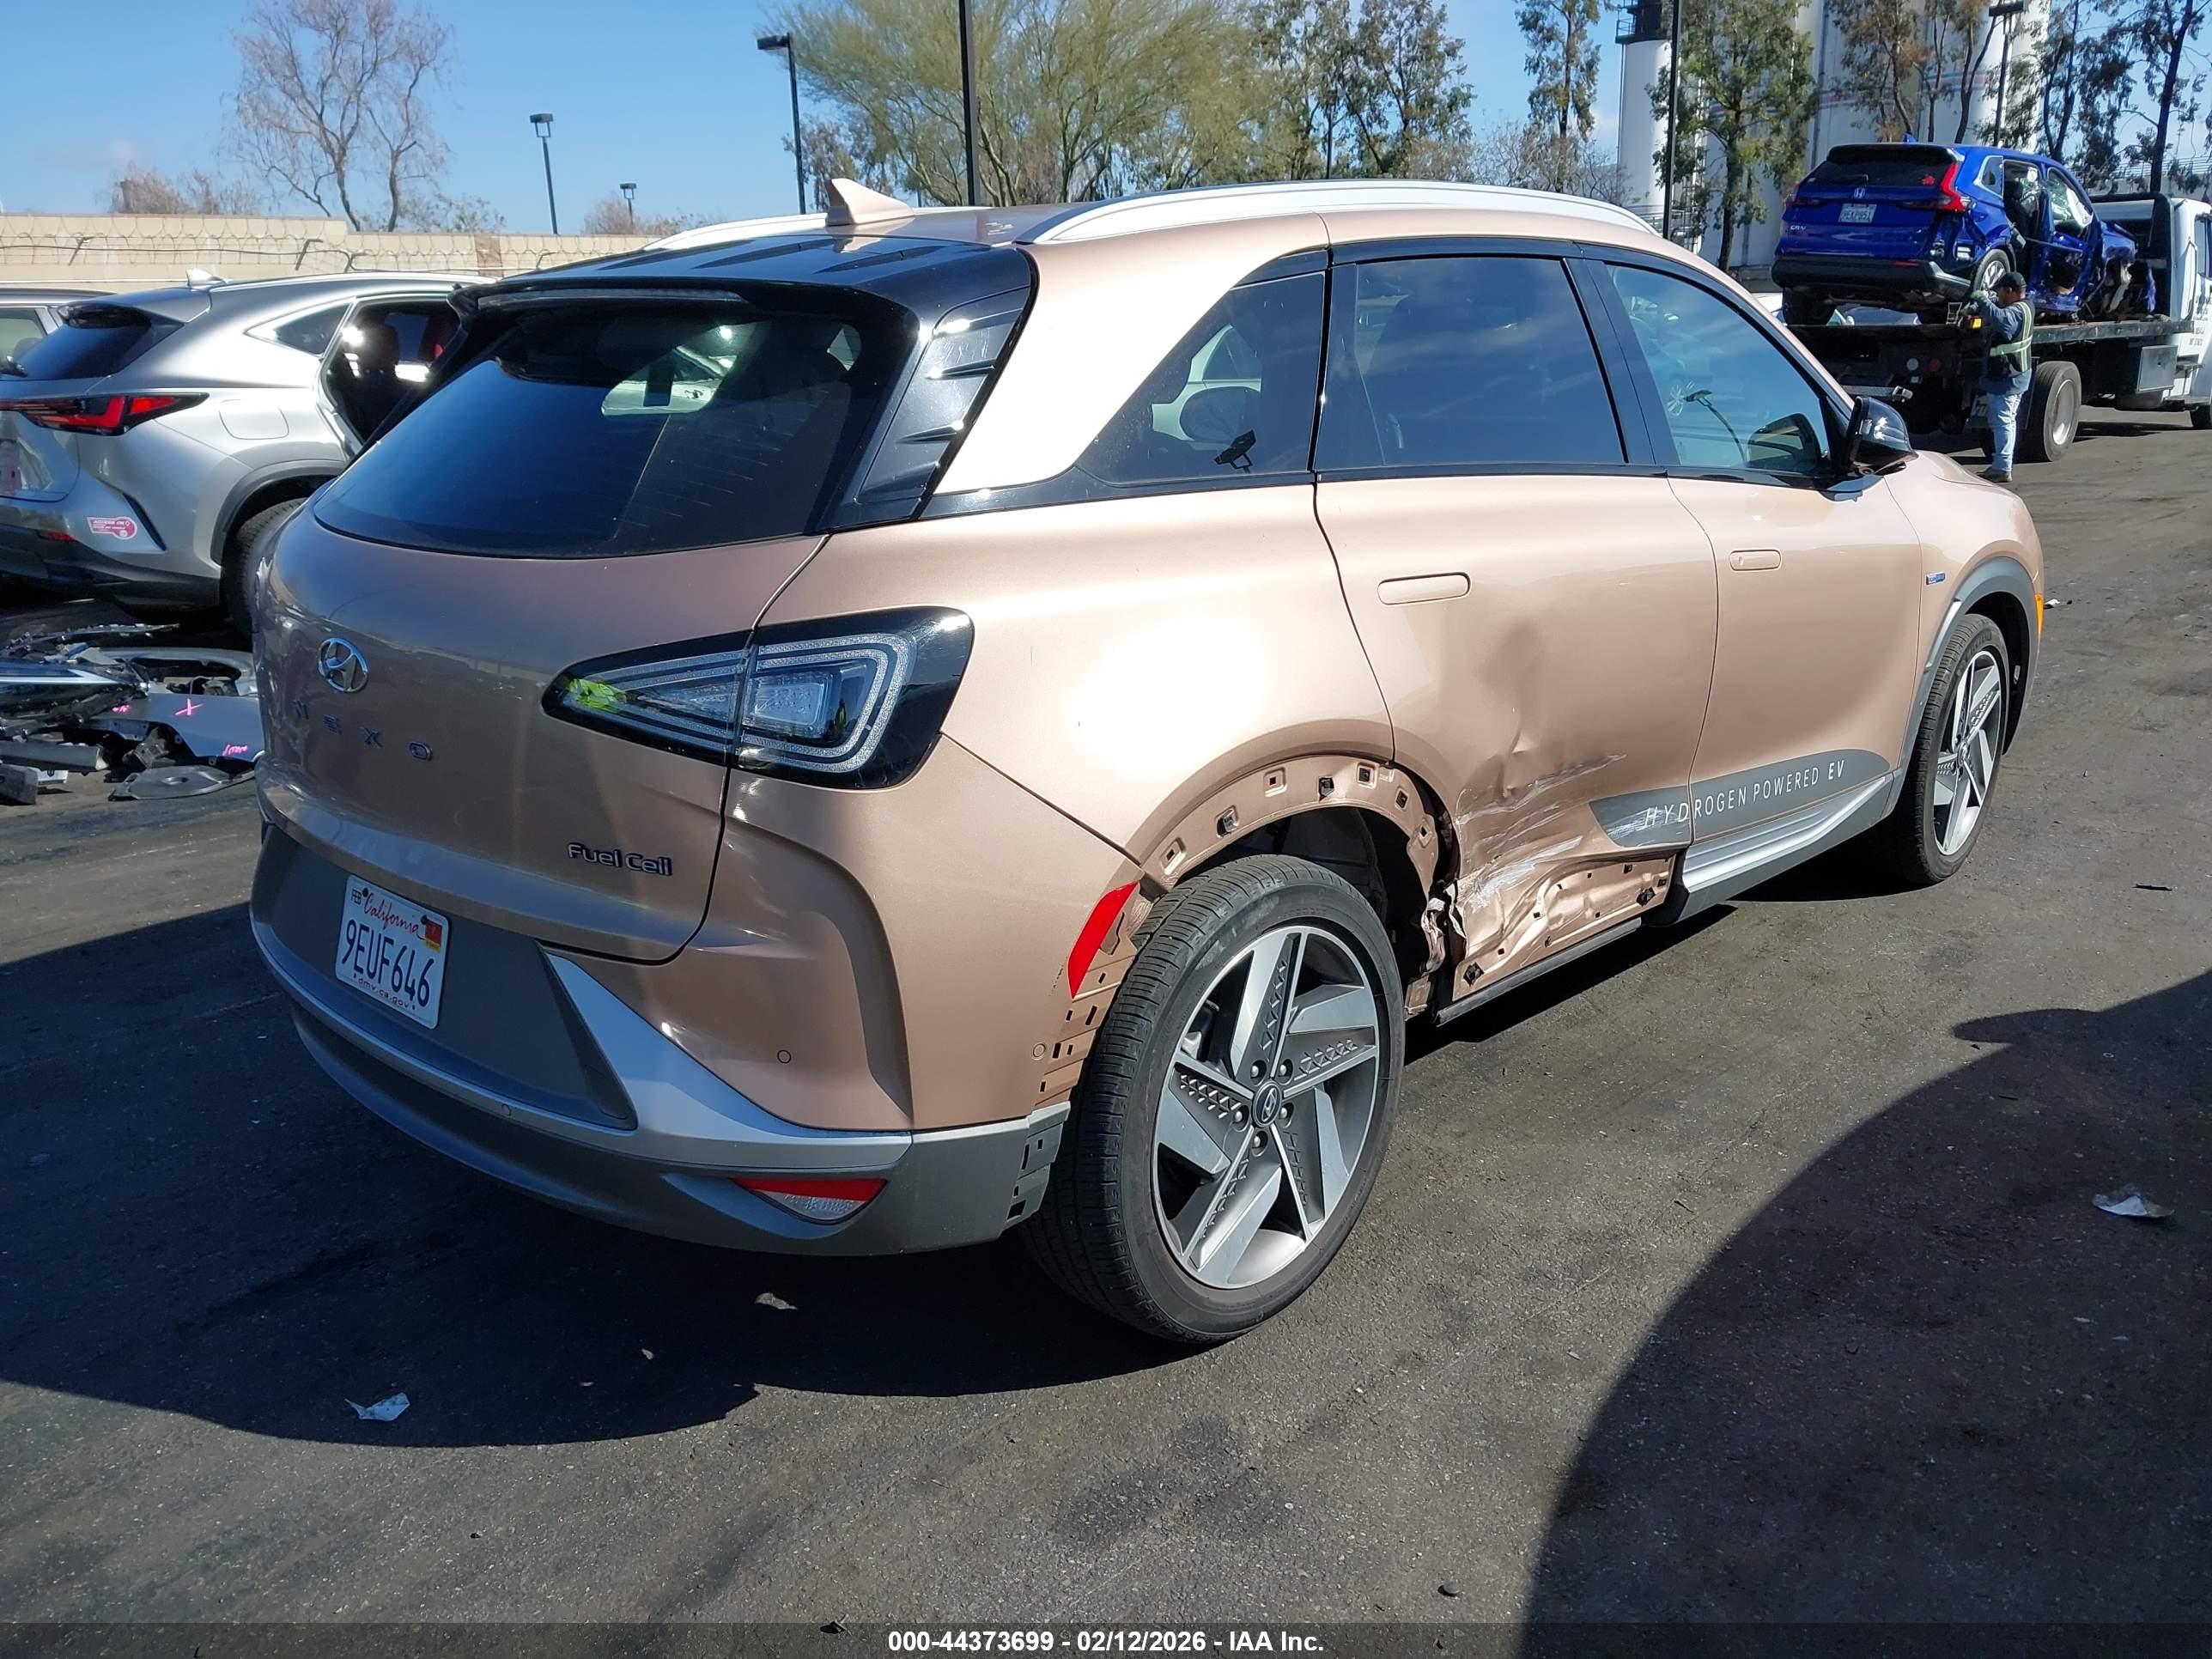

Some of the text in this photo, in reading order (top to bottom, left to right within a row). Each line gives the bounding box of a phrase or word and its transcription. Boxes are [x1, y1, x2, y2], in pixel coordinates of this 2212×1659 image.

[1644, 760, 1844, 826] HYDROGEN POWERED EV
[568, 843, 672, 876] Fuel Cell
[362, 892, 426, 940] California
[342, 920, 434, 1007] 9EUF646
[358, 978, 409, 1009] dmv.ca.gov
